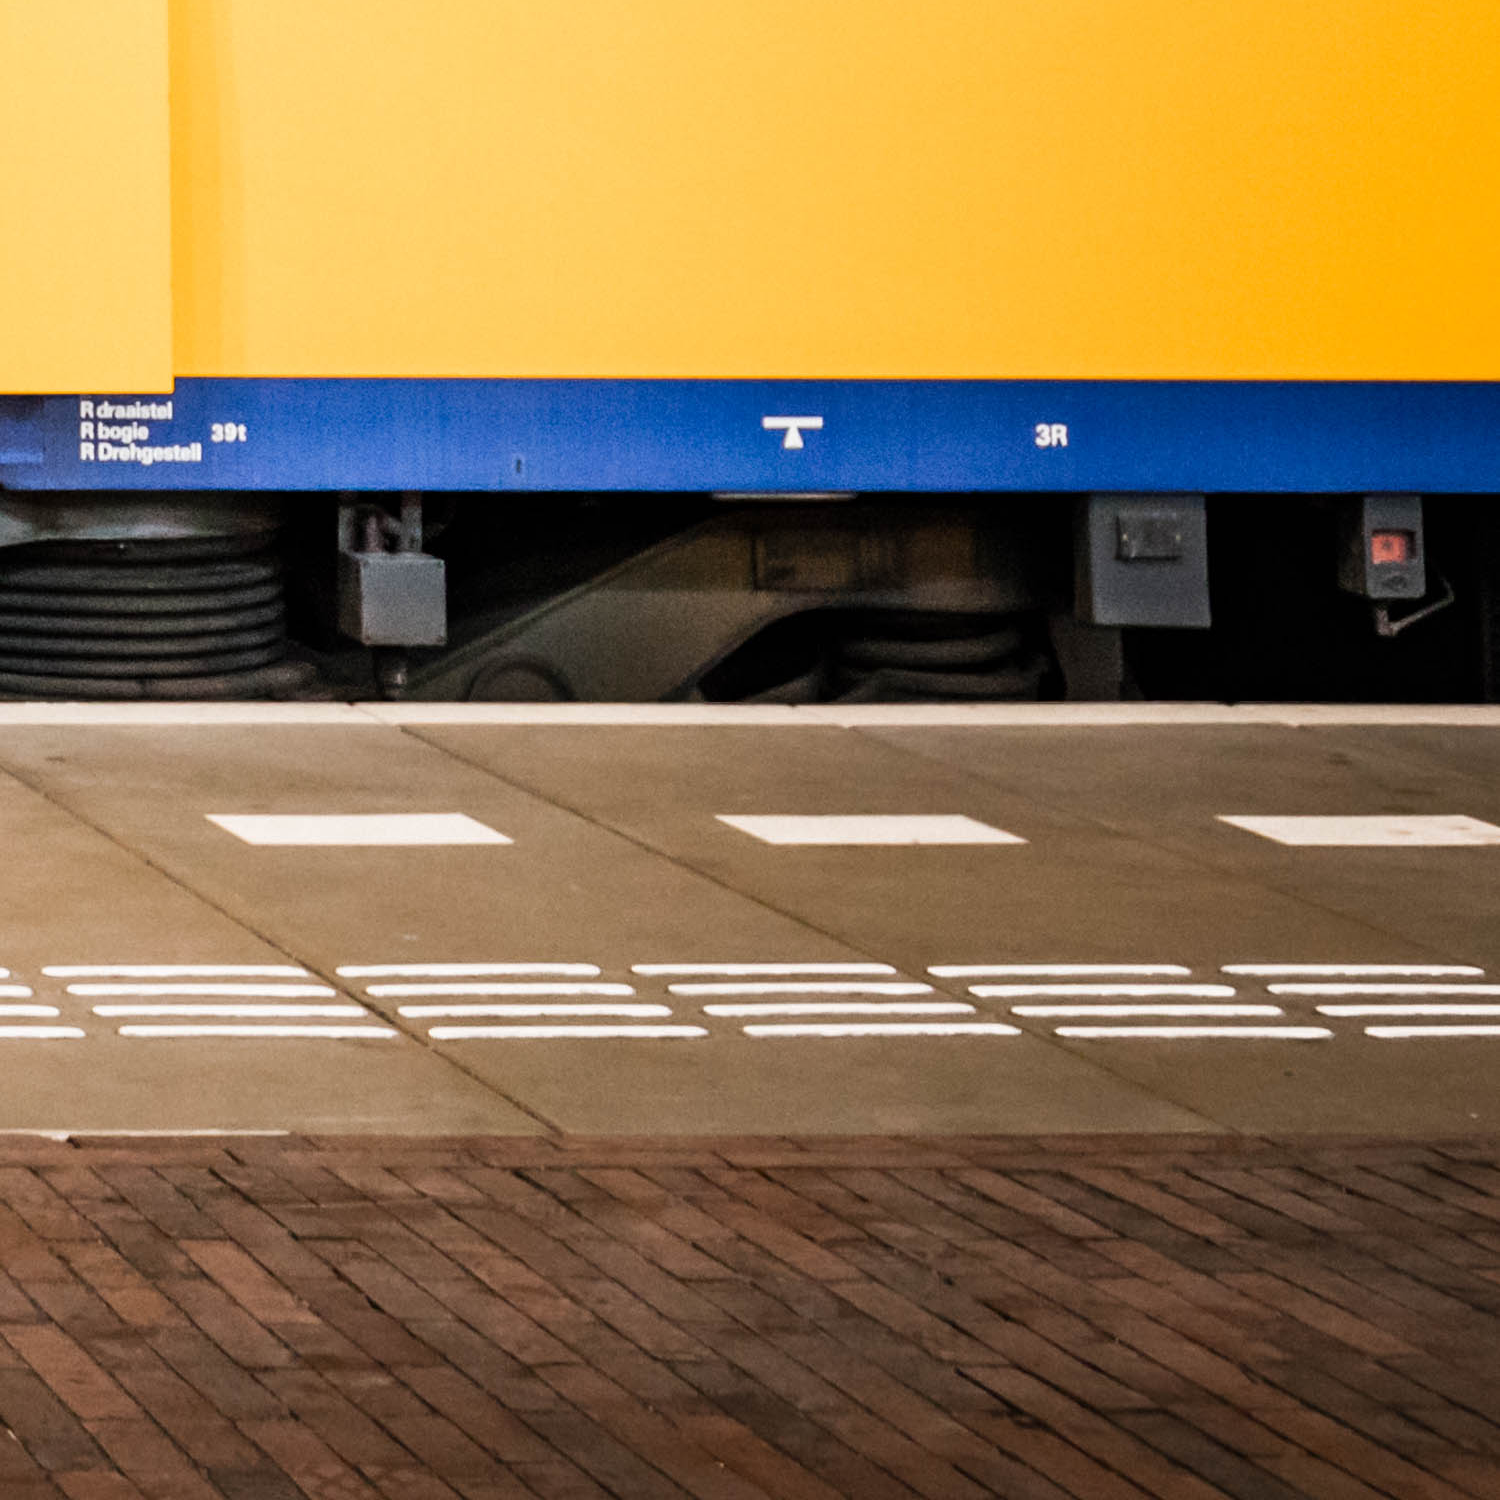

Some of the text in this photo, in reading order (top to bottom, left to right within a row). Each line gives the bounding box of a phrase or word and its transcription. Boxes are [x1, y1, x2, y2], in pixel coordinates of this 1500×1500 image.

[80, 400, 173, 419] R draaistel
[80, 421, 149, 444] R bogie
[210, 422, 247, 442] 39t
[1034, 423, 1069, 447] 3R
[80, 442, 202, 465] R Drehgestell
